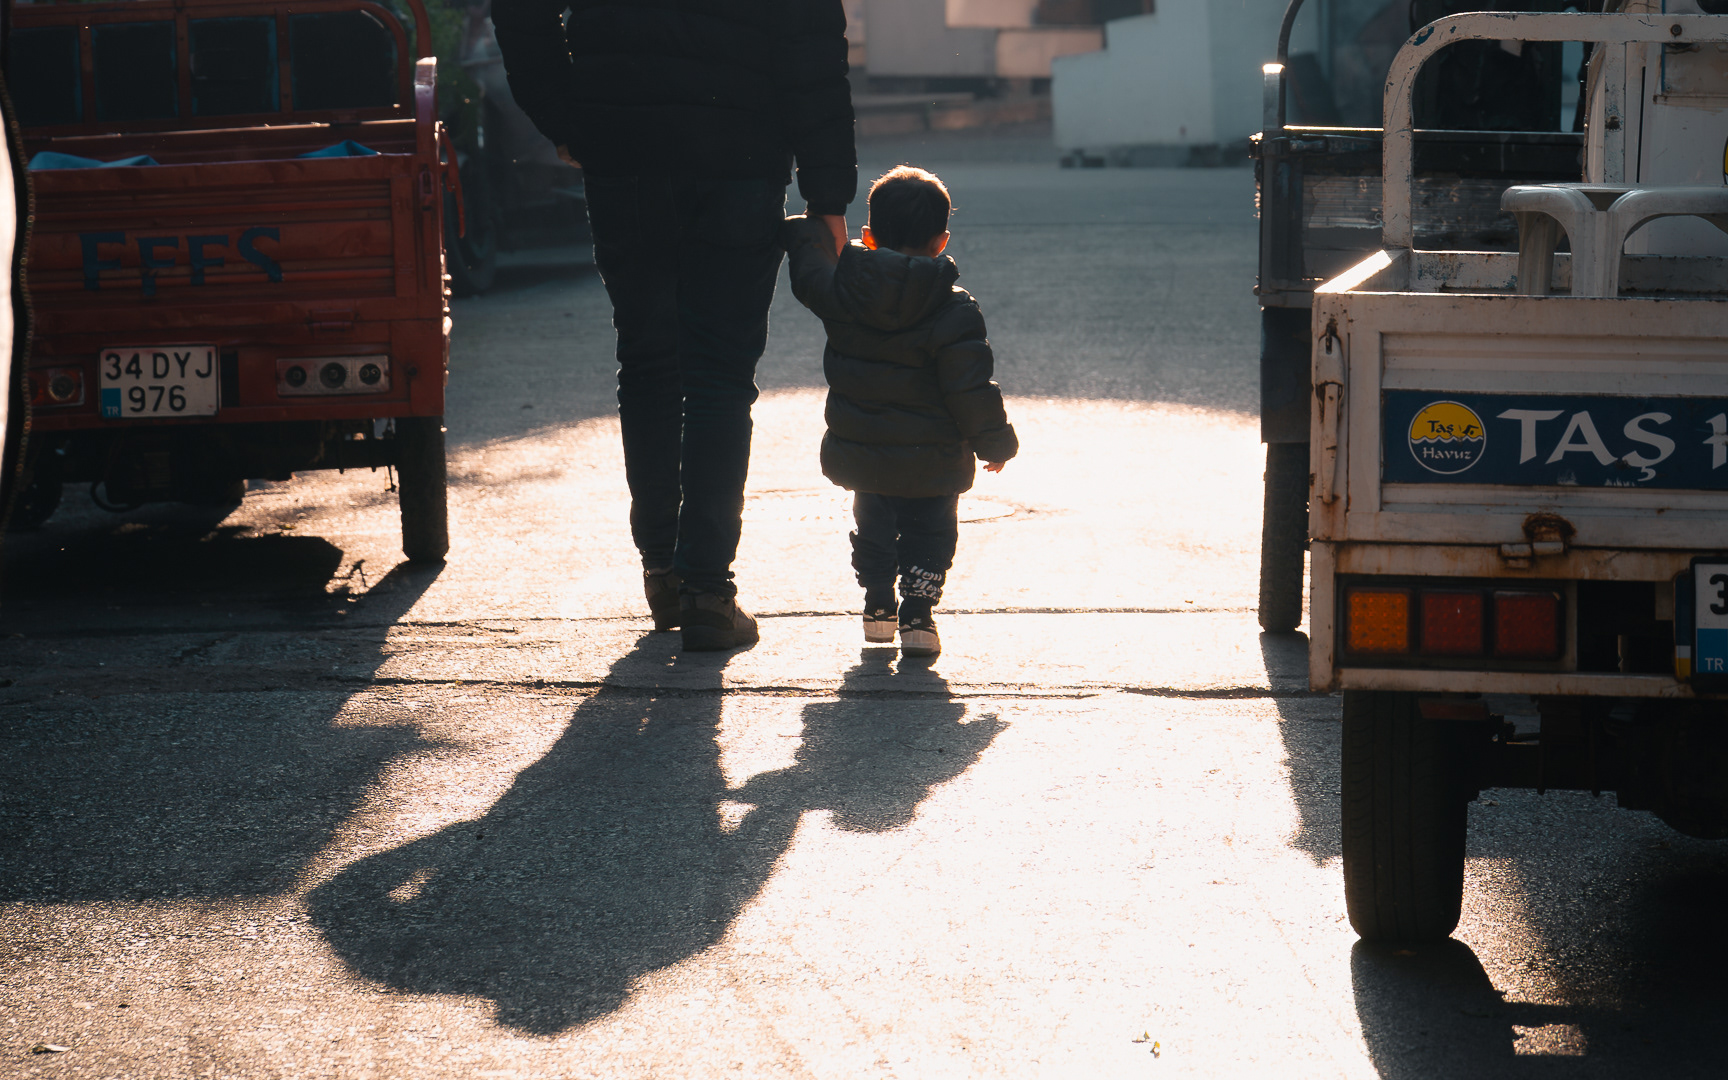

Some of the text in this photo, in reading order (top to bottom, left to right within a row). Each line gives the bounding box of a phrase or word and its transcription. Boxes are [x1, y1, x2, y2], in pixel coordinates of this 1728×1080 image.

[105, 351, 212, 380] 34 DYJ
[128, 384, 187, 413] 976
[105, 406, 119, 416] TR
[1427, 420, 1454, 436] Taş
[1423, 446, 1472, 460] Havuz
[1496, 407, 1676, 483] TAŞ
[1705, 657, 1724, 671] TR
